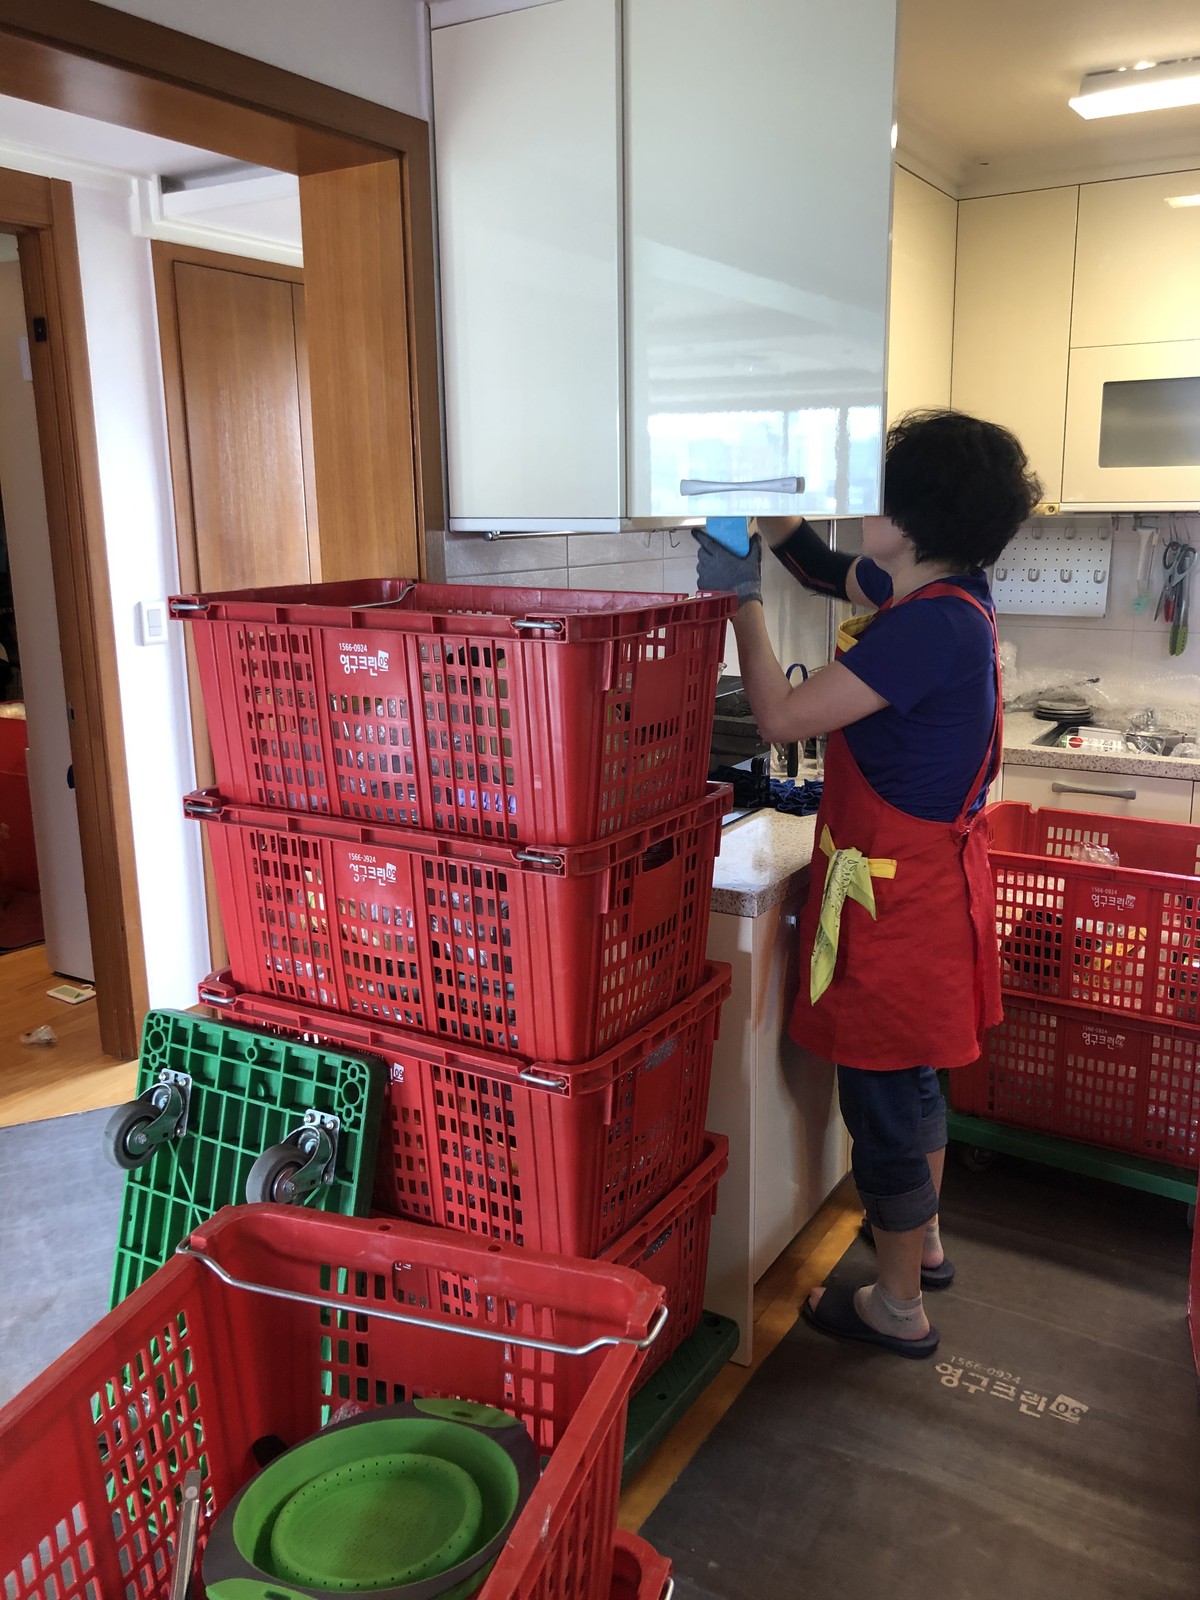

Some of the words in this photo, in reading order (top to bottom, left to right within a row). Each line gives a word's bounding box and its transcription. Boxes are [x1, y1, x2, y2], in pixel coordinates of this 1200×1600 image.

[339, 642, 368, 653] 1566-0924
[339, 654, 378, 677] 영구크린
[349, 863, 386, 886] 영구크린
[1091, 893, 1125, 911] 영구크린
[1082, 1032, 1115, 1050] 영구크린
[949, 1355, 1022, 1385] 1566-0924
[935, 1362, 1048, 1418] 영구크린
